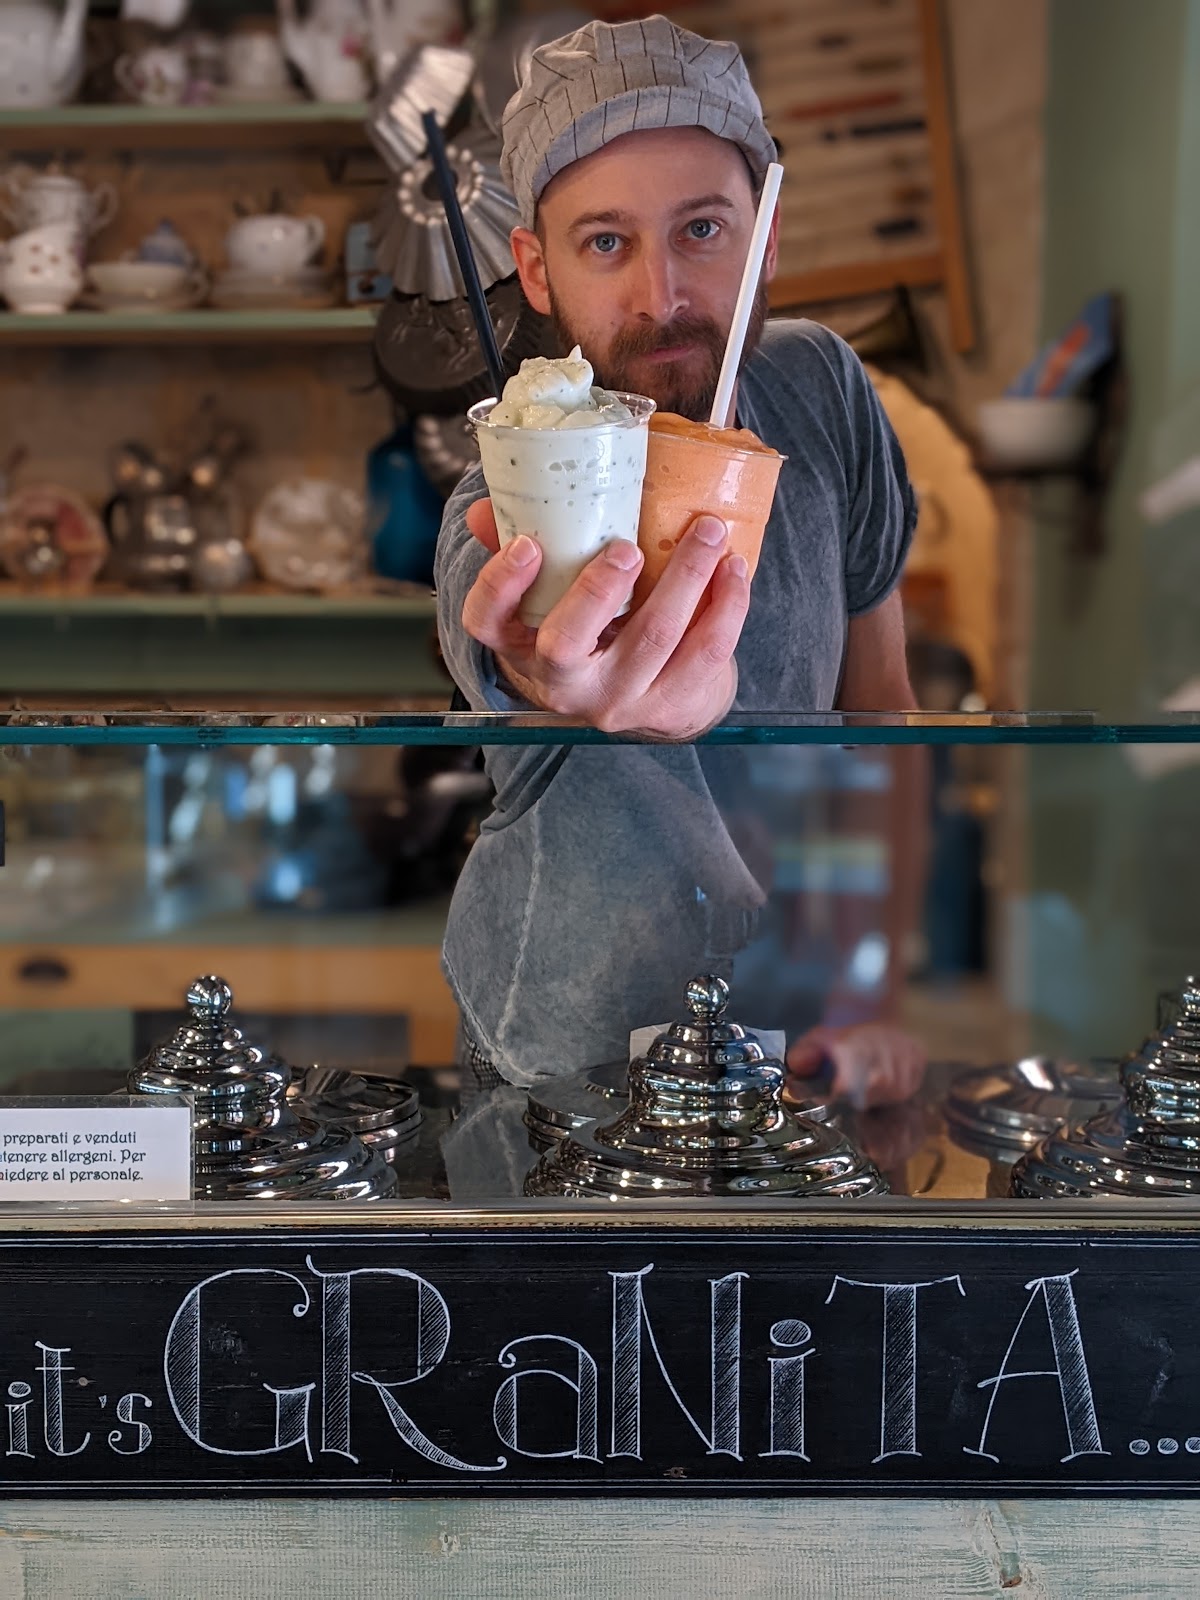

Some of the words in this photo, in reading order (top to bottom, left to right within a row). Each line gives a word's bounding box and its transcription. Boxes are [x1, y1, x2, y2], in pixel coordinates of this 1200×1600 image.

[3, 1131, 68, 1147] preparati
[73, 1134, 82, 1146] e
[85, 1131, 137, 1146] venduti
[51, 1149, 116, 1165] allergeni.
[120, 1149, 147, 1164] Per
[52, 1167, 65, 1181] al
[70, 1168, 144, 1183] personale.
[5, 1340, 153, 1459] it's
